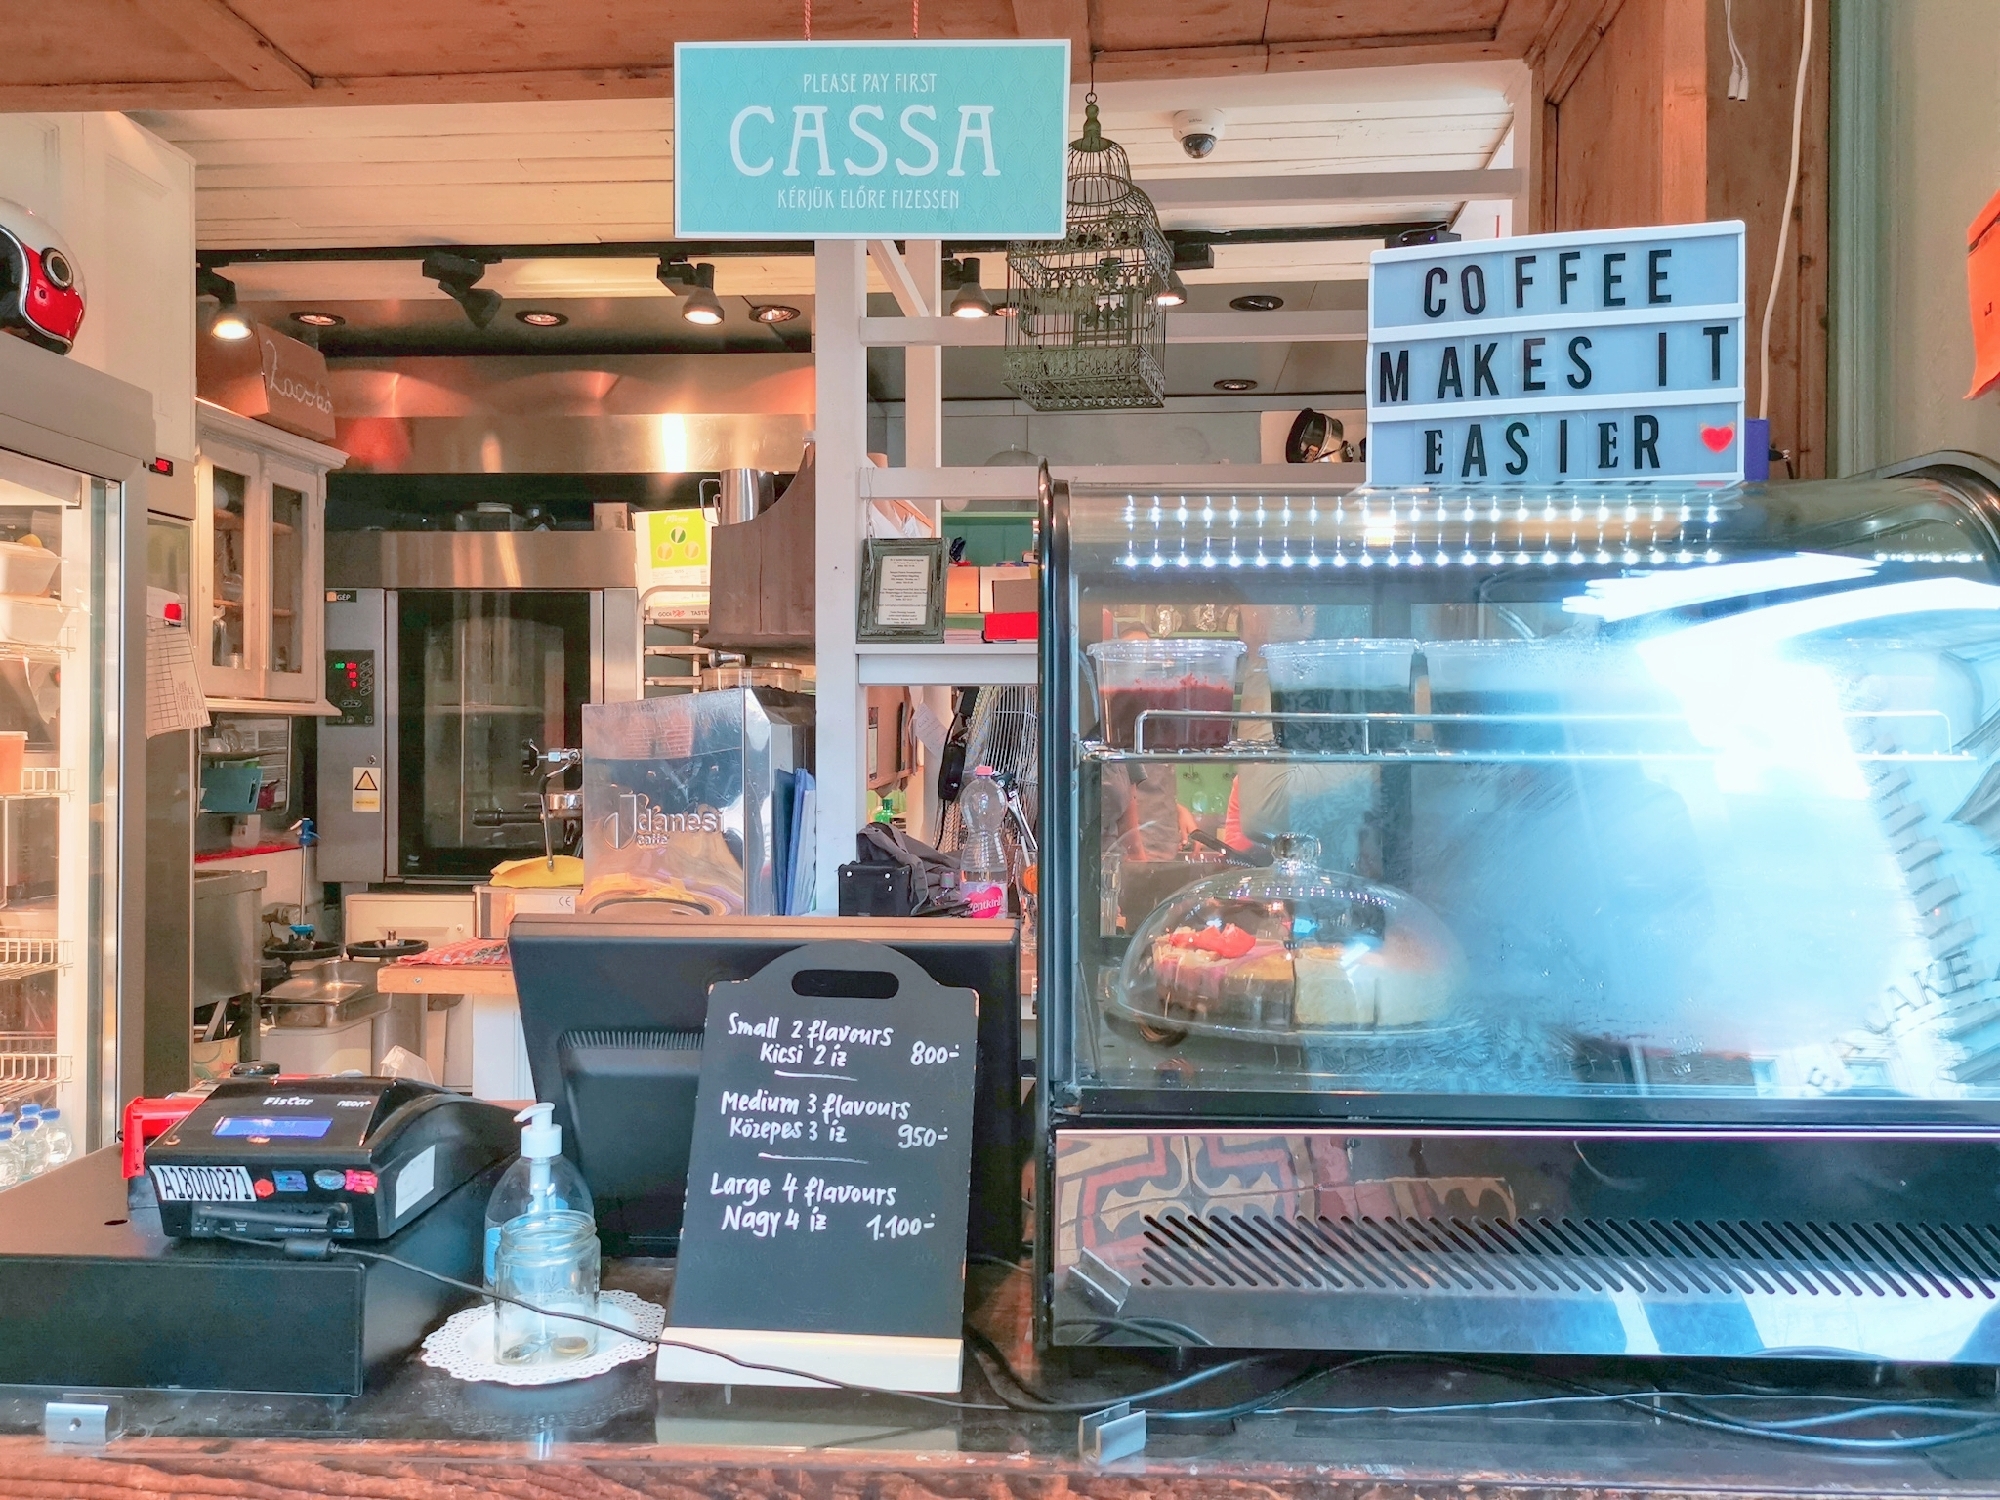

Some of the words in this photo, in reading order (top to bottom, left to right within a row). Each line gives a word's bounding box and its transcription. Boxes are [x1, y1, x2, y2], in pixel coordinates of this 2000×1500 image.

[803, 73, 857, 93] PLEASE
[863, 73, 890, 93] PAY
[895, 73, 938, 93] FIRST
[729, 105, 1001, 177] CASSA
[777, 187, 835, 212] KÉRJÜK
[841, 184, 886, 209] ELŐRE
[891, 189, 960, 210] FIZESSEN
[1424, 249, 1672, 318] COFFEE
[1379, 337, 1593, 403] MAKES
[1658, 326, 1729, 387] IT
[1424, 415, 1661, 478] EASIER
[728, 1012, 780, 1039] Small
[790, 1020, 804, 1039] 2
[806, 1019, 895, 1048] flavours
[759, 1041, 804, 1064] Kicsi
[812, 1045, 827, 1066] 2
[720, 1089, 800, 1115] Medium
[806, 1093, 818, 1114] 3
[821, 1093, 911, 1124] flavours
[729, 1117, 804, 1146] Közepes
[808, 1120, 819, 1142] 3
[159, 1166, 252, 1200] A18000371
[710, 1172, 772, 1207] Large
[781, 1172, 799, 1203] 4
[803, 1176, 897, 1207] flavours
[721, 1205, 781, 1238] Nagy
[783, 1208, 800, 1231] 4
